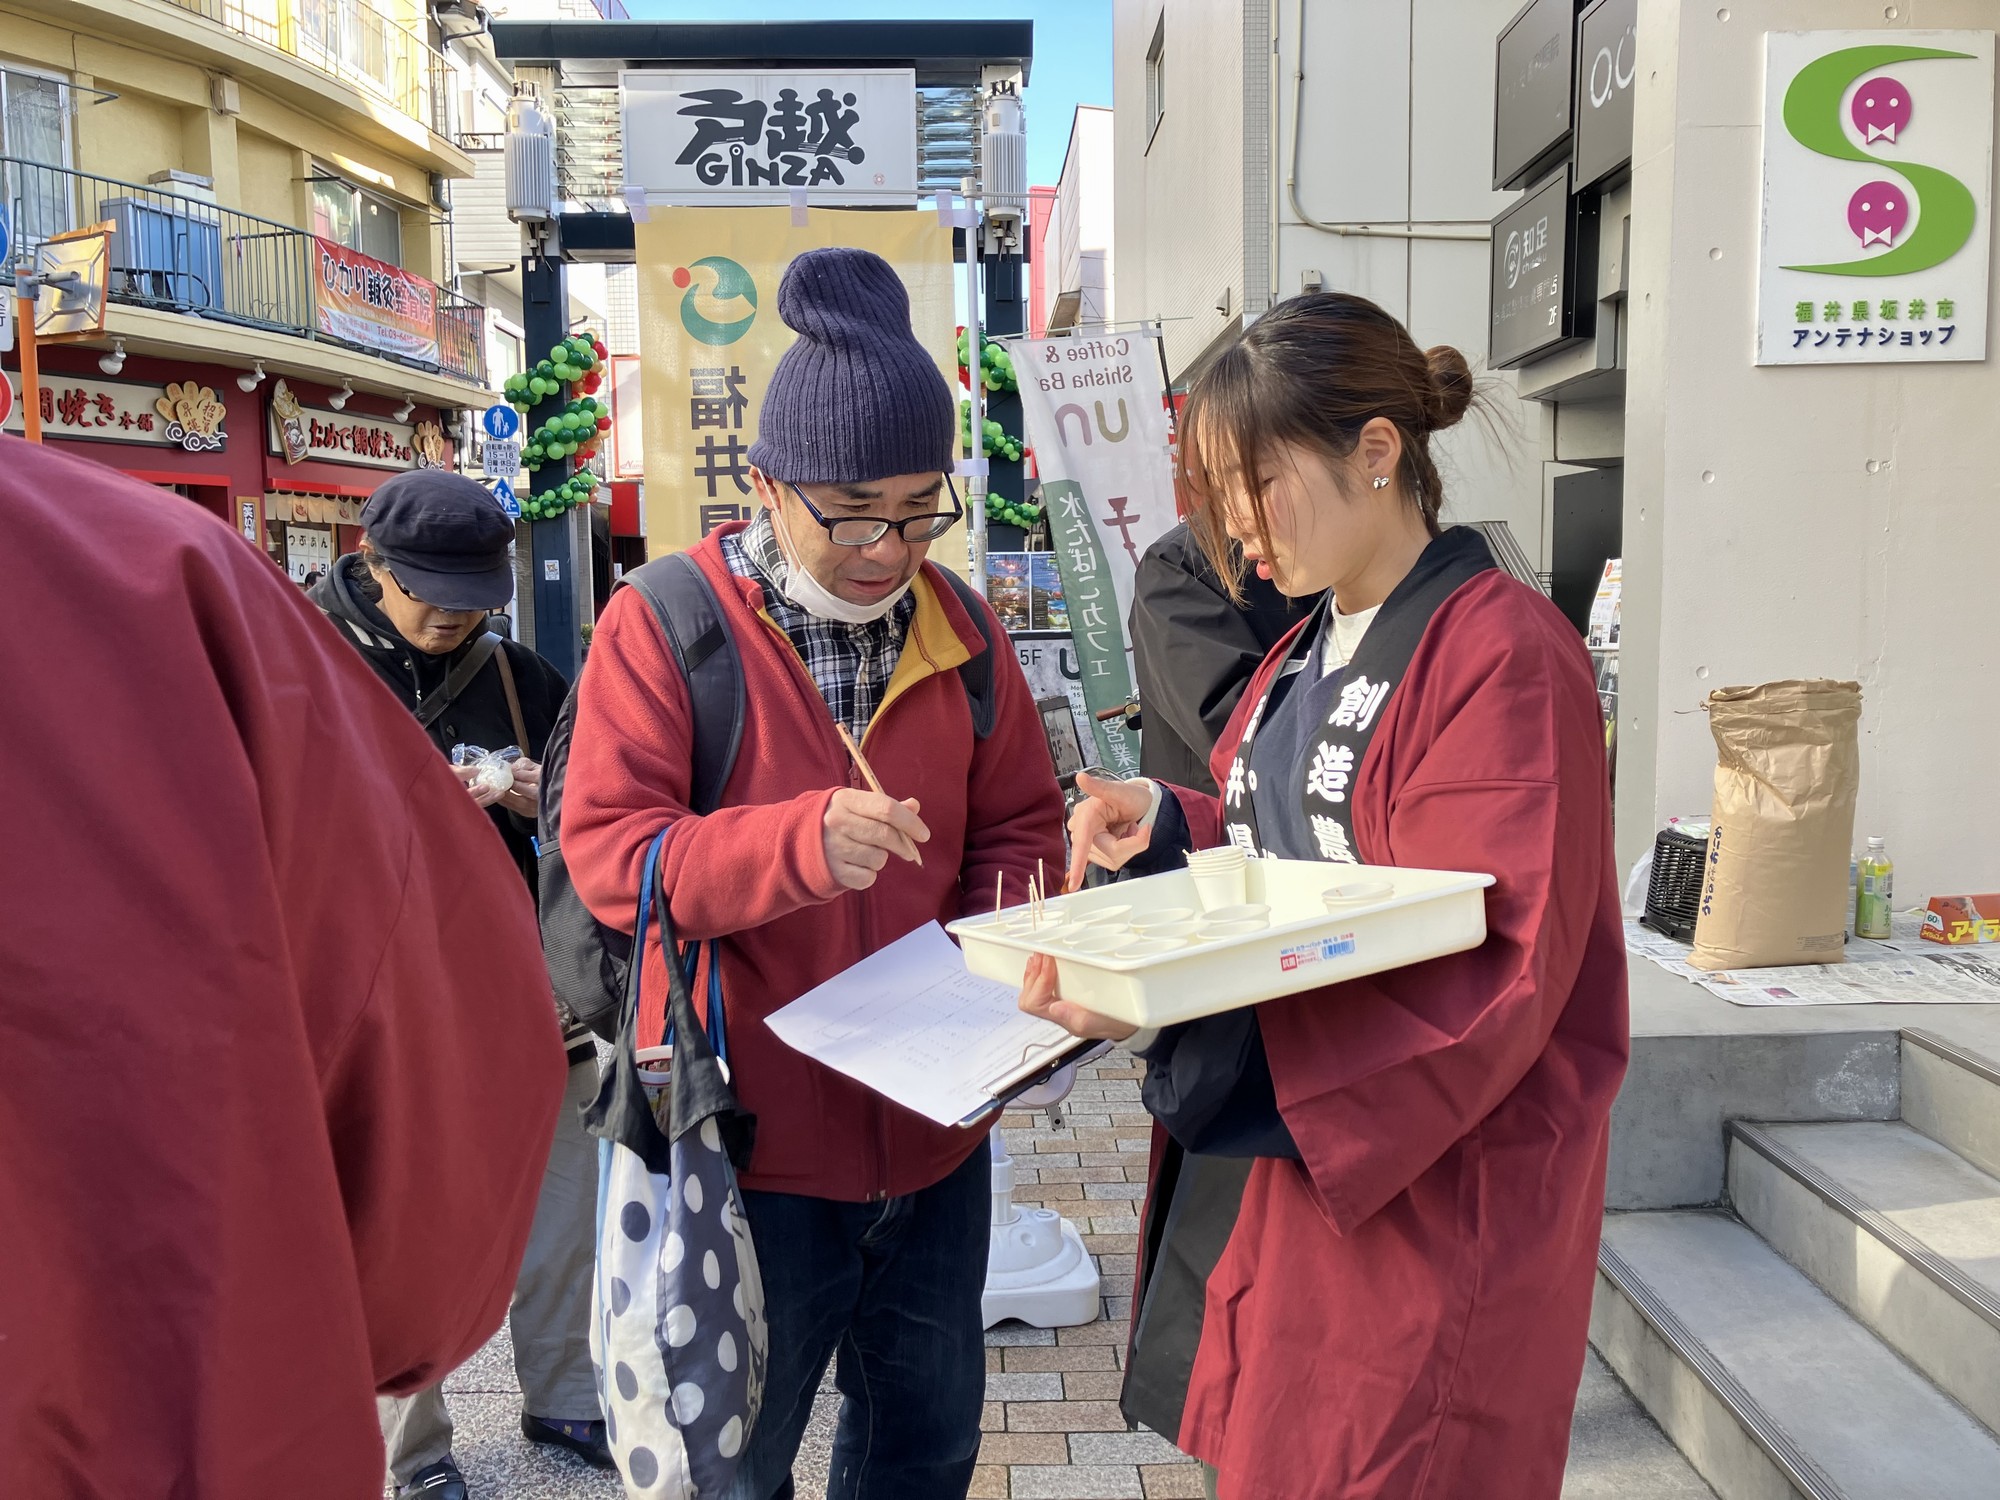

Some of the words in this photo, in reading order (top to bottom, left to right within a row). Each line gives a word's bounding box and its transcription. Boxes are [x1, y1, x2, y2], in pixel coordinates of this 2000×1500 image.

[675, 88, 865, 165] 戸越
[696, 144, 845, 186] GINZA
[1522, 216, 1548, 260] 知足
[1795, 298, 1954, 323] 福井県坂井市
[1792, 324, 1956, 348] アンテナショップ
[489, 466, 514, 474] 14-19
[288, 535, 328, 549] つぶあん
[1020, 649, 1042, 666] 5F
[1947, 919, 2000, 942] アイラ
